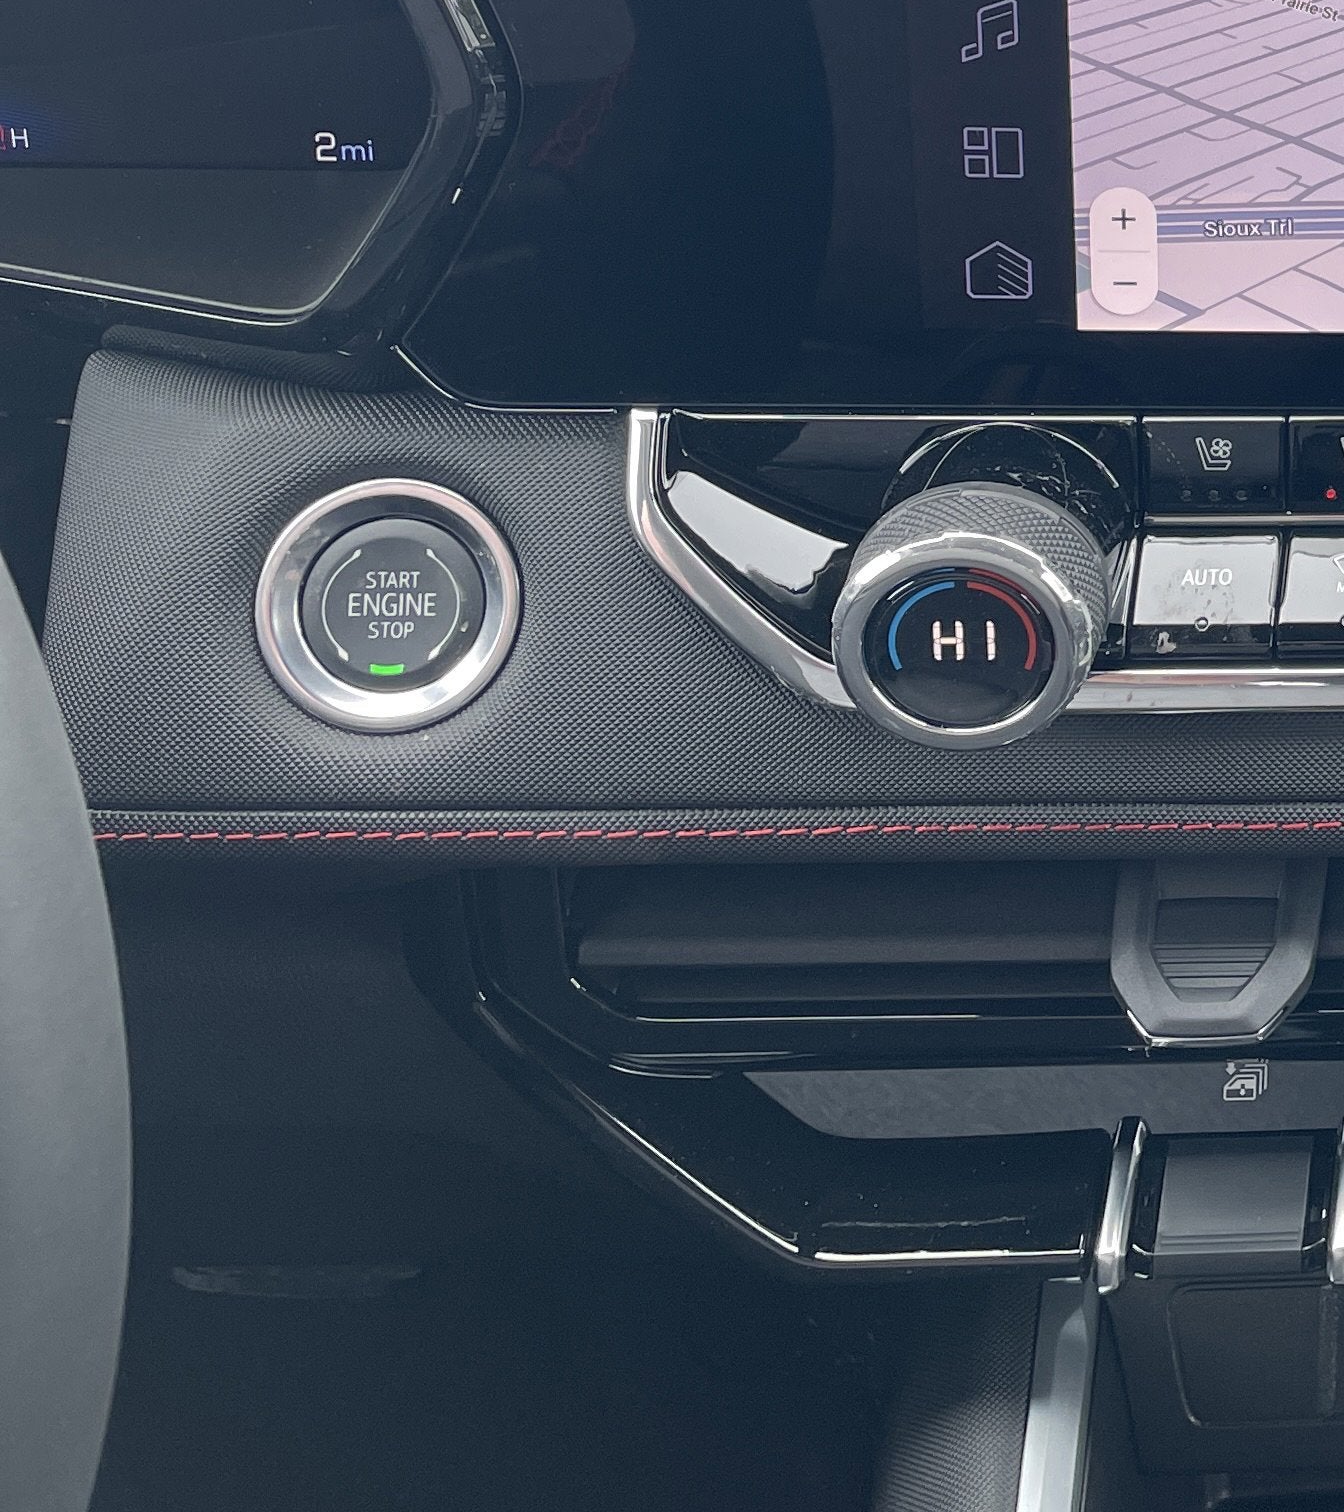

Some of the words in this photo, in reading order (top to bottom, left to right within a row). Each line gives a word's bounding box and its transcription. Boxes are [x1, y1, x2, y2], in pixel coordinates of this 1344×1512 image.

[10, 128, 29, 148] H
[1204, 220, 1261, 237] Sioux
[1268, 219, 1294, 236] Trl
[366, 571, 420, 589] START
[1182, 568, 1233, 586] AUTO
[347, 593, 436, 617] ENGINE
[368, 621, 414, 639] STOP
